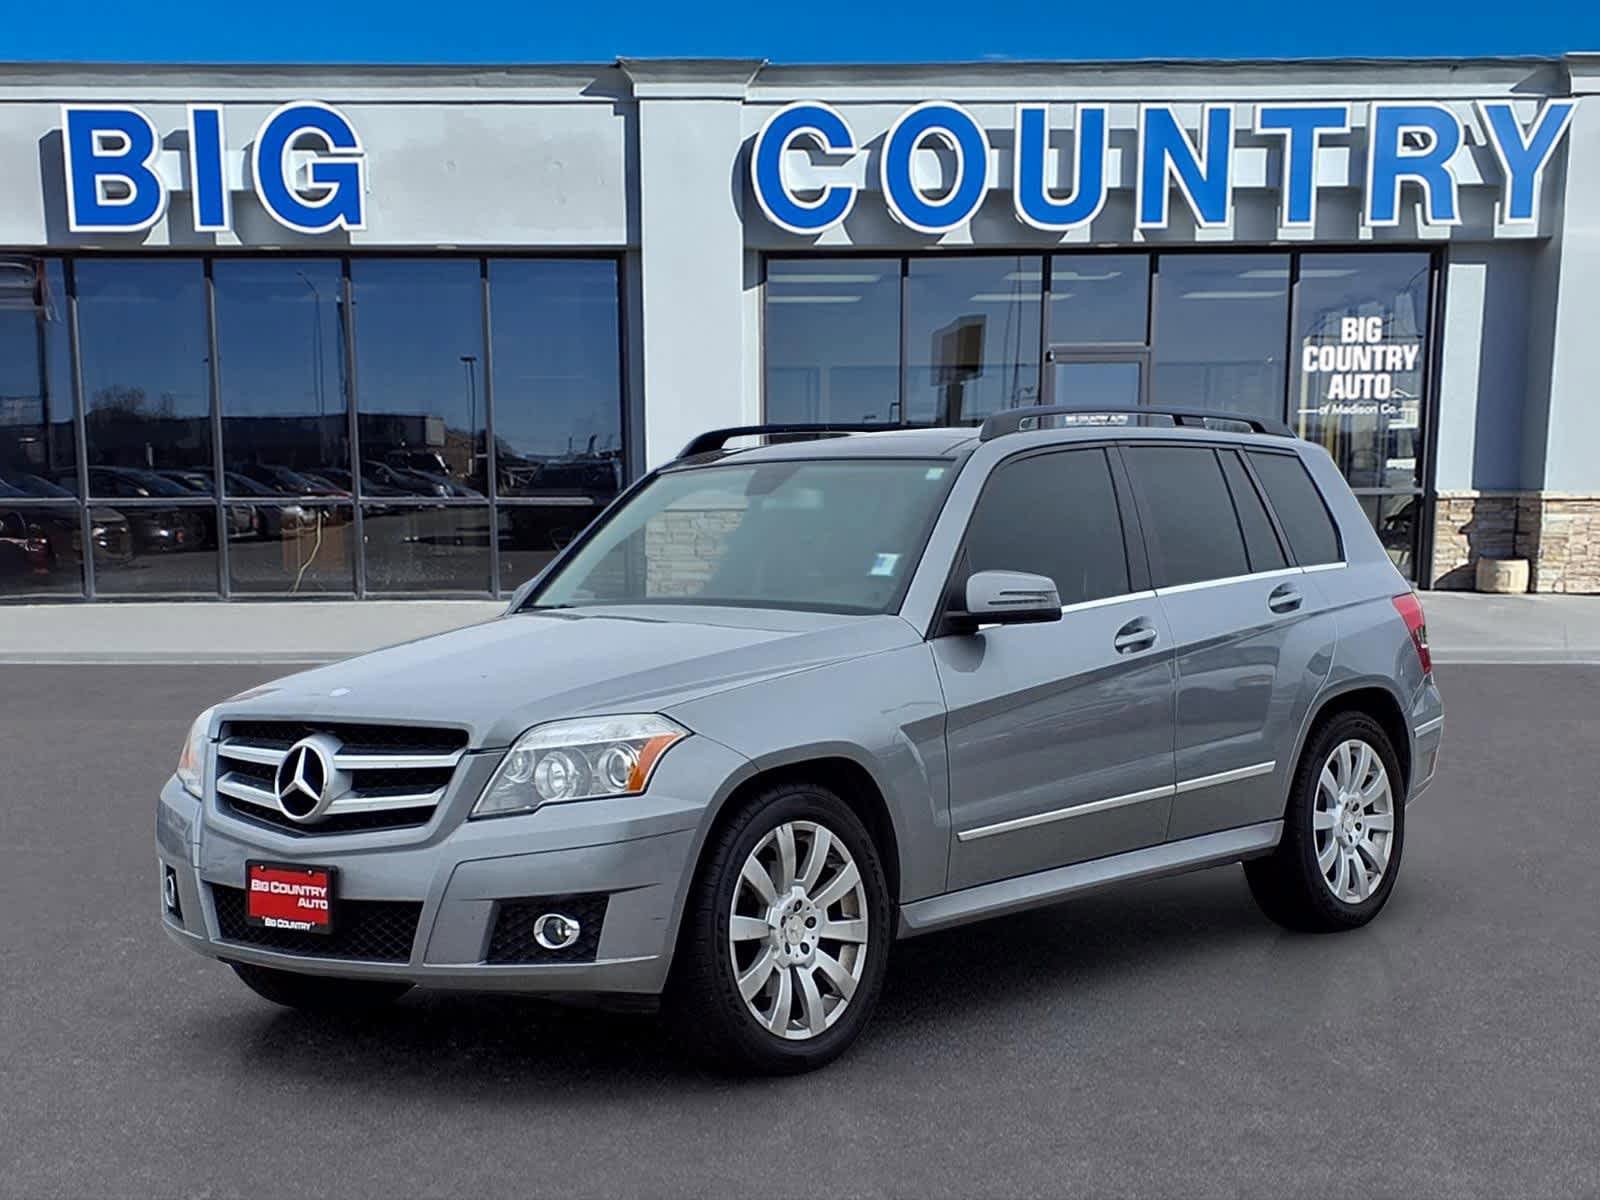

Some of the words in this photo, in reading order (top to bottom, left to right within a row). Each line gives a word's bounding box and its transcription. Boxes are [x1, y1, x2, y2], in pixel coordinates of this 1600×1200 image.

[60, 100, 367, 234] BIG
[751, 99, 1575, 235] COUNTRY
[1341, 316, 1382, 343] BIG
[1302, 345, 1419, 372] COUNTRY
[1328, 373, 1391, 399] AUTO
[1319, 403, 1329, 415] of
[1331, 403, 1378, 414] Madison
[270, 881, 327, 897] COUNTRY
[298, 897, 328, 910] AUTO
